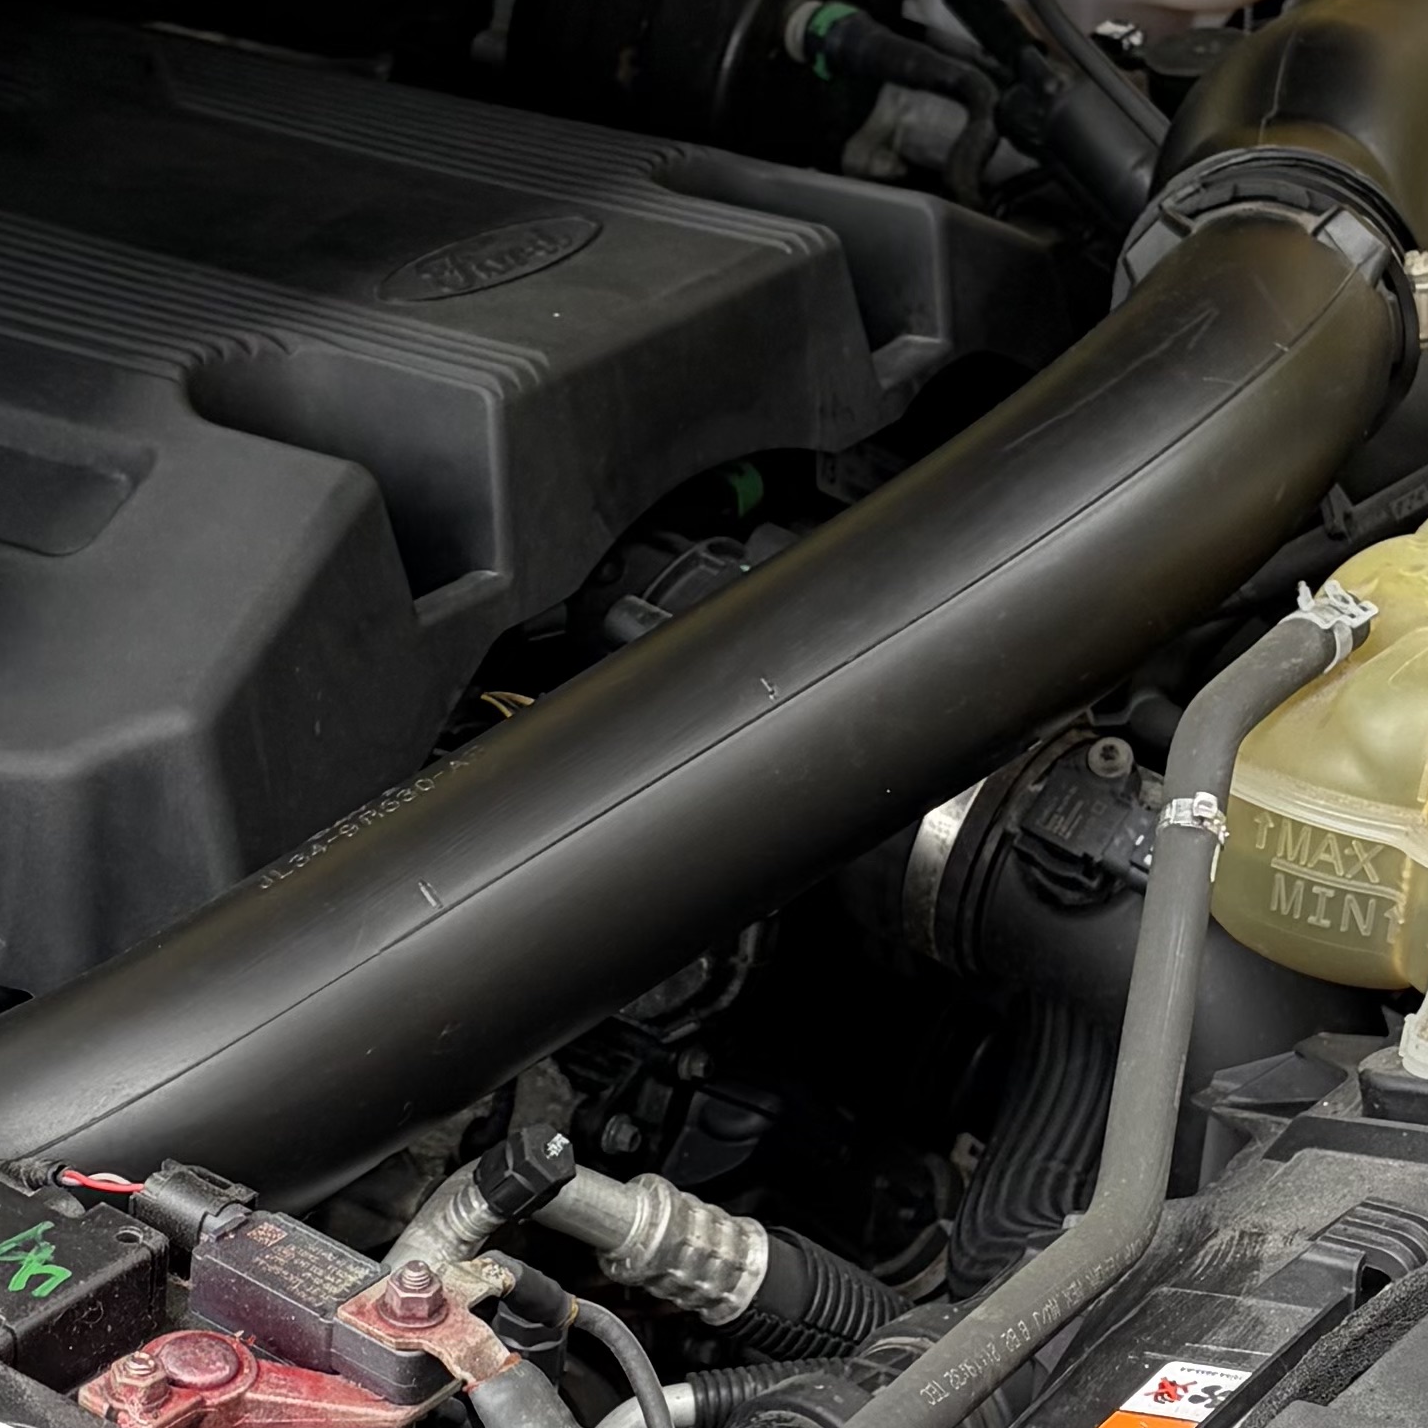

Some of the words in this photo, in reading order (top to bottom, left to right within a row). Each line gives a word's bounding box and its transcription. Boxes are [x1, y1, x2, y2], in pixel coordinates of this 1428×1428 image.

[415, 227, 572, 292] Ford
[1276, 818, 1385, 884] MAX
[1269, 871, 1377, 937] MIN
